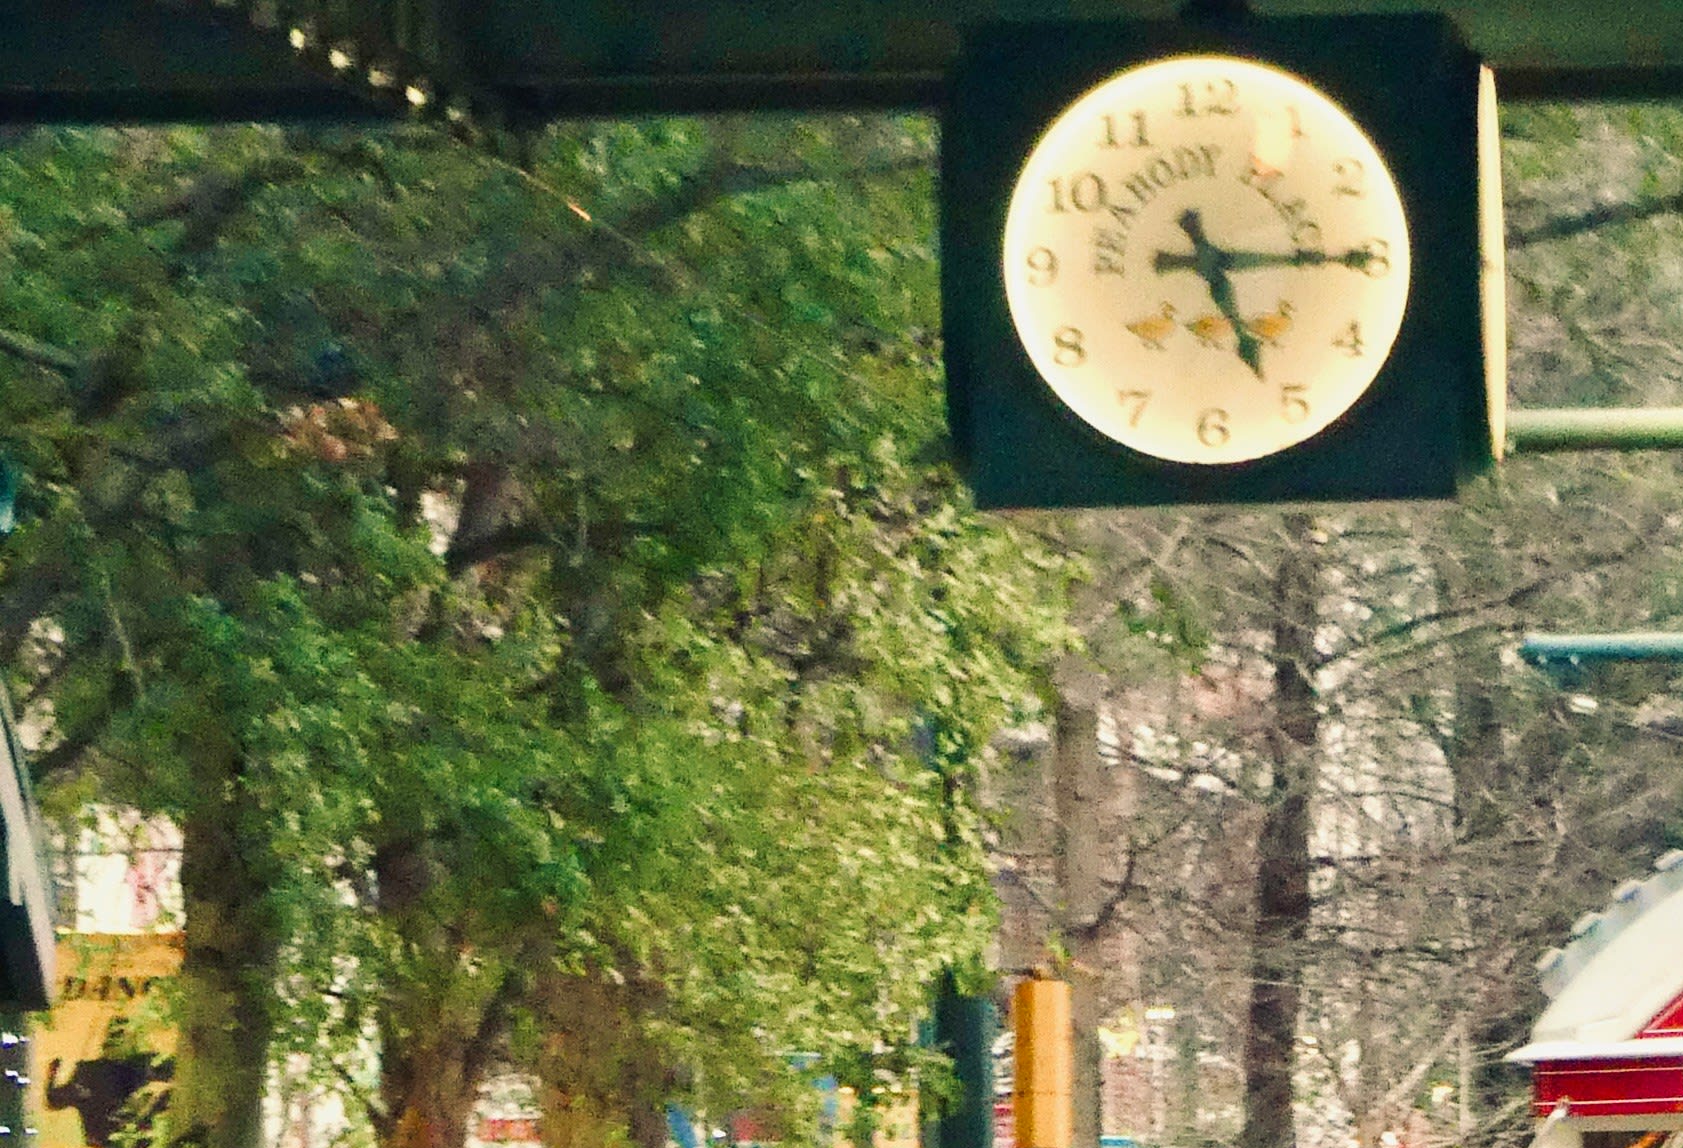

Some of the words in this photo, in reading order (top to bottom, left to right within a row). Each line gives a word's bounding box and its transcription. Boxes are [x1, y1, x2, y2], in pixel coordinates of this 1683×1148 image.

[1173, 78, 1240, 118] 12
[1098, 108, 1151, 149] 11
[1048, 171, 1109, 213] 10
[1332, 157, 1365, 197] 2
[1093, 143, 1223, 278] PEABODY
[1026, 246, 1060, 288] 9
[1052, 323, 1088, 368] 8
[1331, 319, 1364, 358] 4
[1117, 389, 1152, 430] 7
[1280, 382, 1311, 425] 5
[1195, 407, 1231, 448] 6
